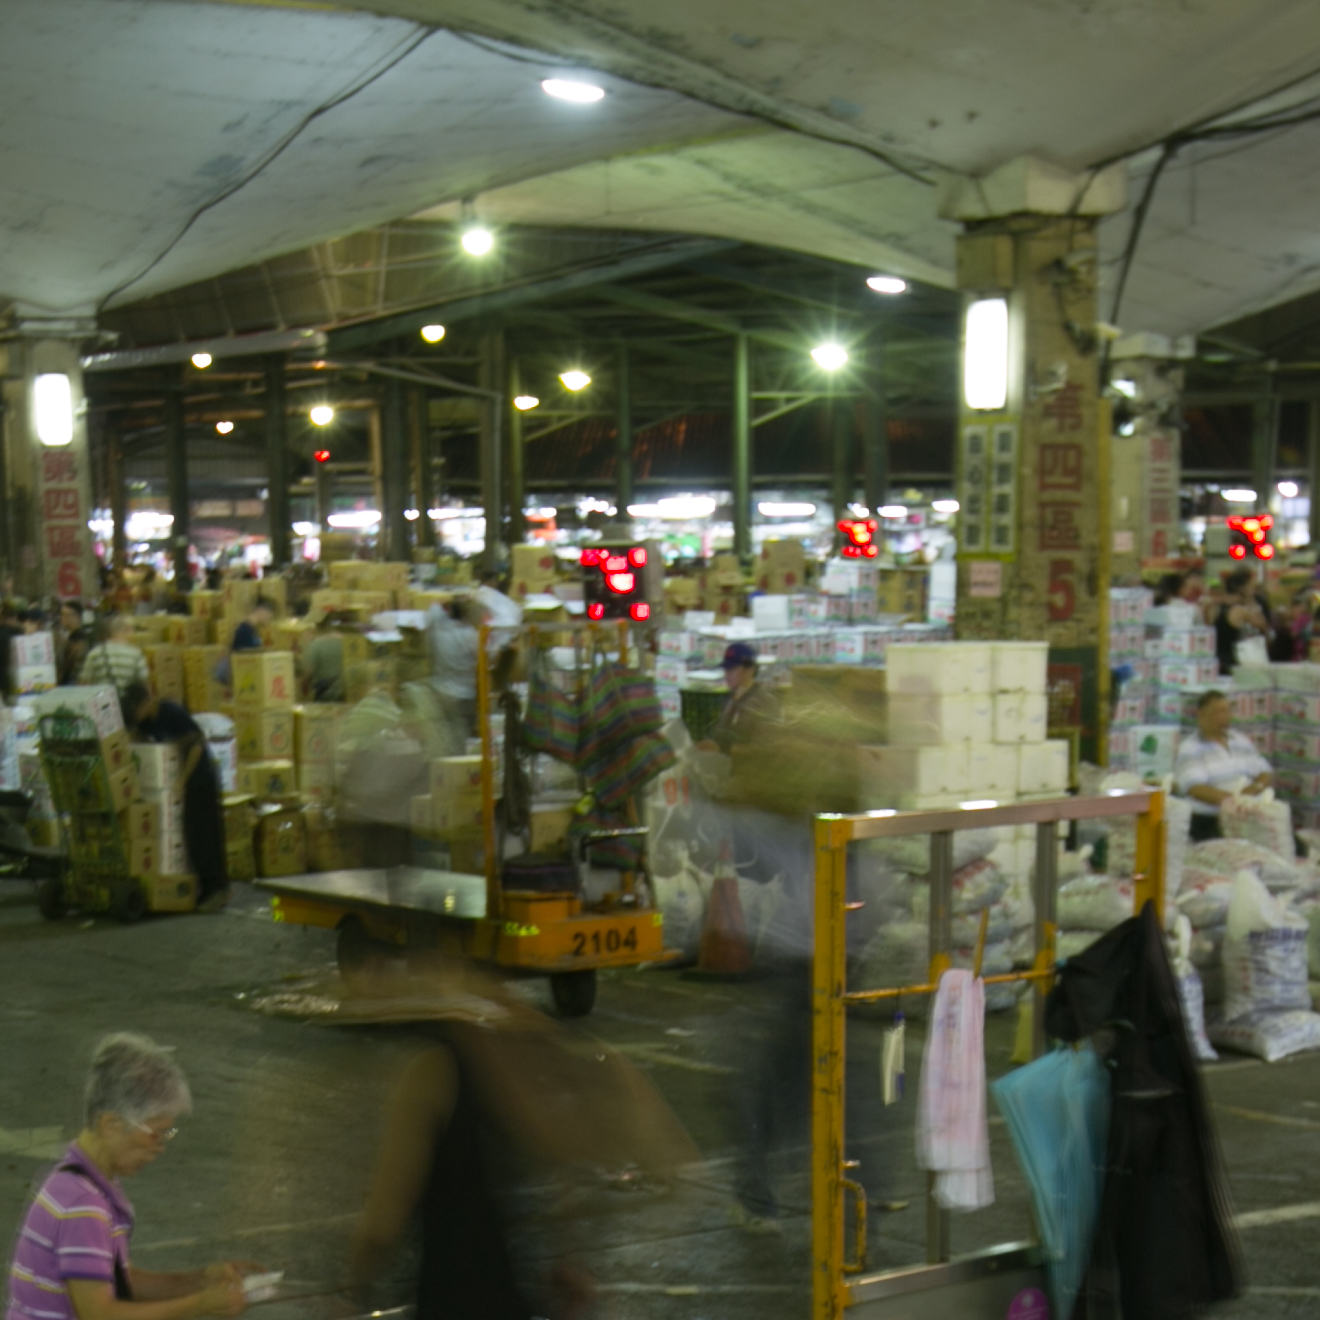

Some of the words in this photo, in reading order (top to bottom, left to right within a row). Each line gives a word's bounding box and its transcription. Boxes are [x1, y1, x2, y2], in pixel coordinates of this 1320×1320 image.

[41, 450, 83, 598] 第四區6
[571, 927, 638, 957] 2104
